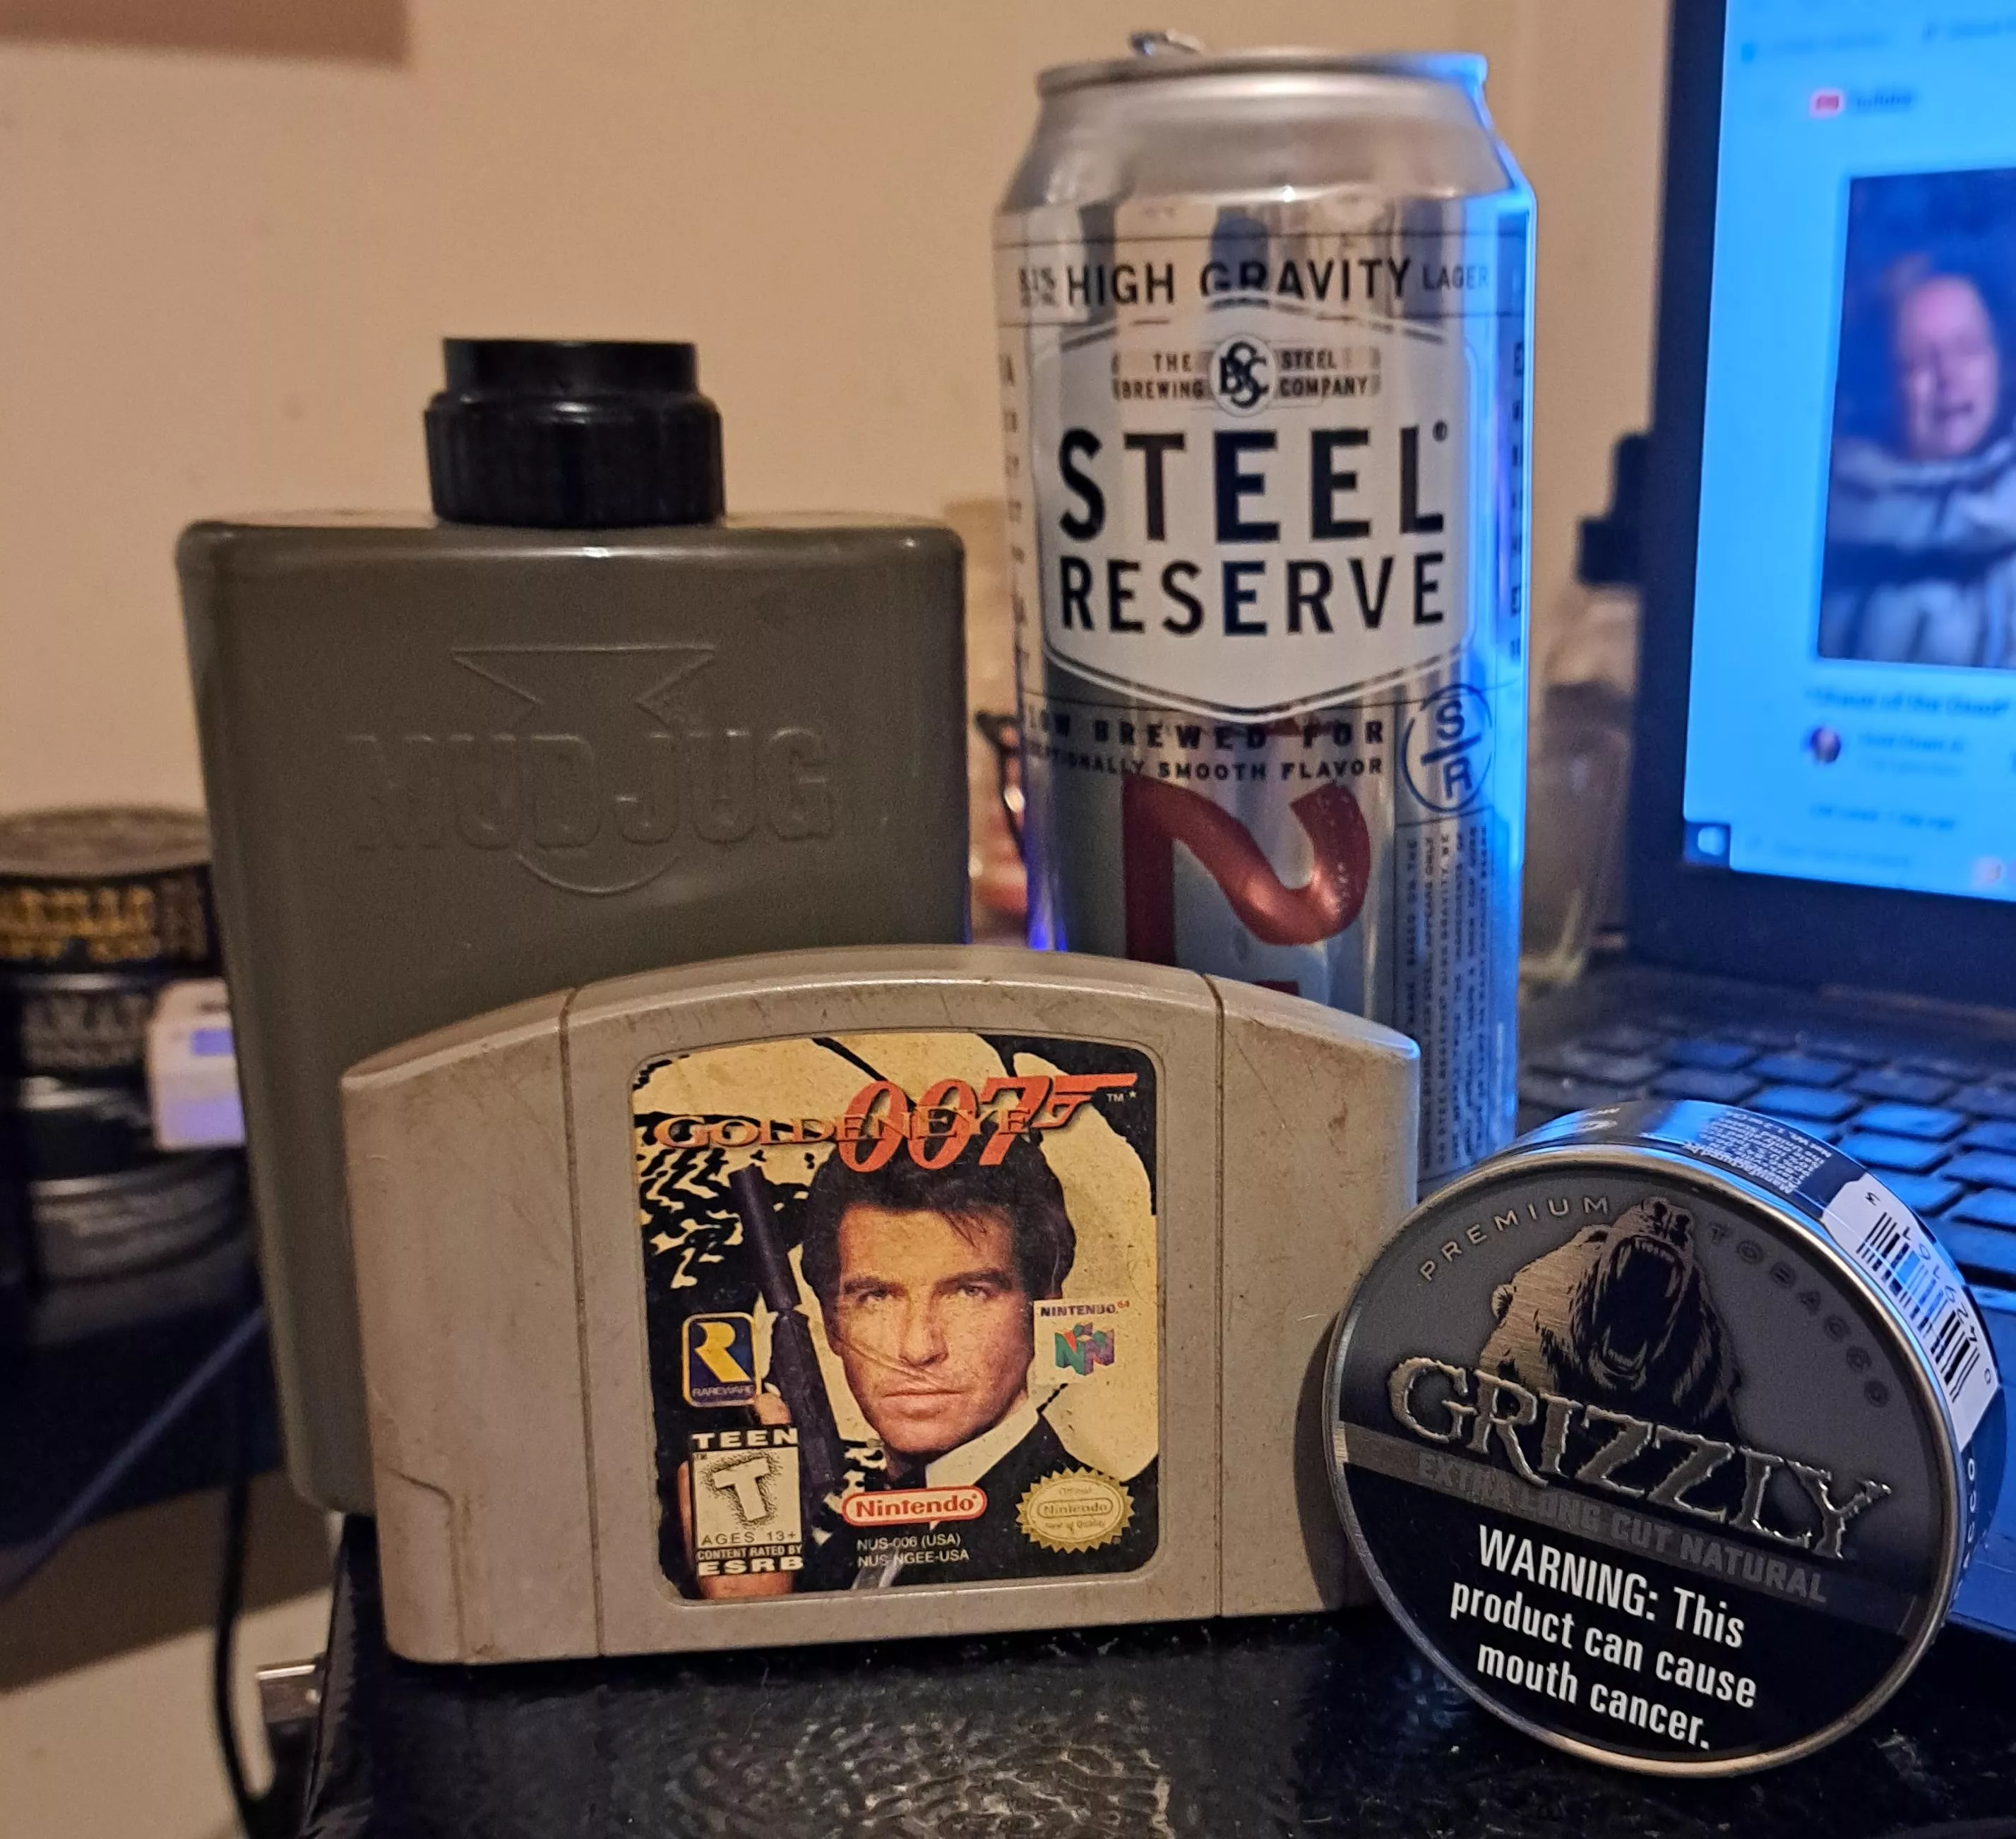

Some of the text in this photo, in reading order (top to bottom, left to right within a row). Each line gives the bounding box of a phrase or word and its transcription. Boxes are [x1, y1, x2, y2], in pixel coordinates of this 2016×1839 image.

[1067, 262, 1174, 306] HIGH
[1198, 257, 1411, 303] GRAVITY
[1421, 264, 1489, 290] LAGER
[1154, 349, 1337, 371] THE STEEL
[1121, 376, 1368, 401] BREWING COMPANY
[1059, 425, 1445, 543] STEEL
[1059, 553, 1445, 635] RESERVE
[1095, 717, 1266, 751] BREWED
[1304, 720, 1383, 749] FOR
[1159, 761, 1266, 780] SMOOTH
[1282, 757, 1382, 780] FLAVOR
[653, 1106, 1031, 1149] GOLDENEYE
[837, 1073, 1138, 1174] 007
[1727, 1130, 1787, 1156] Imported
[1700, 1148, 1792, 1194] Manufactured
[1731, 1147, 1802, 1185] Clarksville,
[1864, 1191, 1883, 1207] 3
[1419, 1194, 1611, 1283] PREMIUM
[1040, 1305, 1116, 1317] NINTENDO
[691, 1427, 799, 1449] TEEN
[1388, 1356, 1892, 1558] GRIZZLY
[710, 1456, 773, 1521] T
[855, 1494, 974, 1518] Nintendo
[697, 1544, 803, 1560] CONTENT RATED BY
[700, 1530, 797, 1546] AGES 13+
[856, 1532, 962, 1552] NUS-006 (USA)
[697, 1555, 804, 1577] ESRB
[857, 1549, 970, 1568] NUS-NGEE-USA
[1609, 1511, 1673, 1554] CUT
[1680, 1532, 1827, 1604] NATURAL
[1479, 1524, 1746, 1649] WARNING: This
[1450, 1581, 1758, 1709] product can cause
[1477, 1643, 1710, 1751] mouth cancer.
